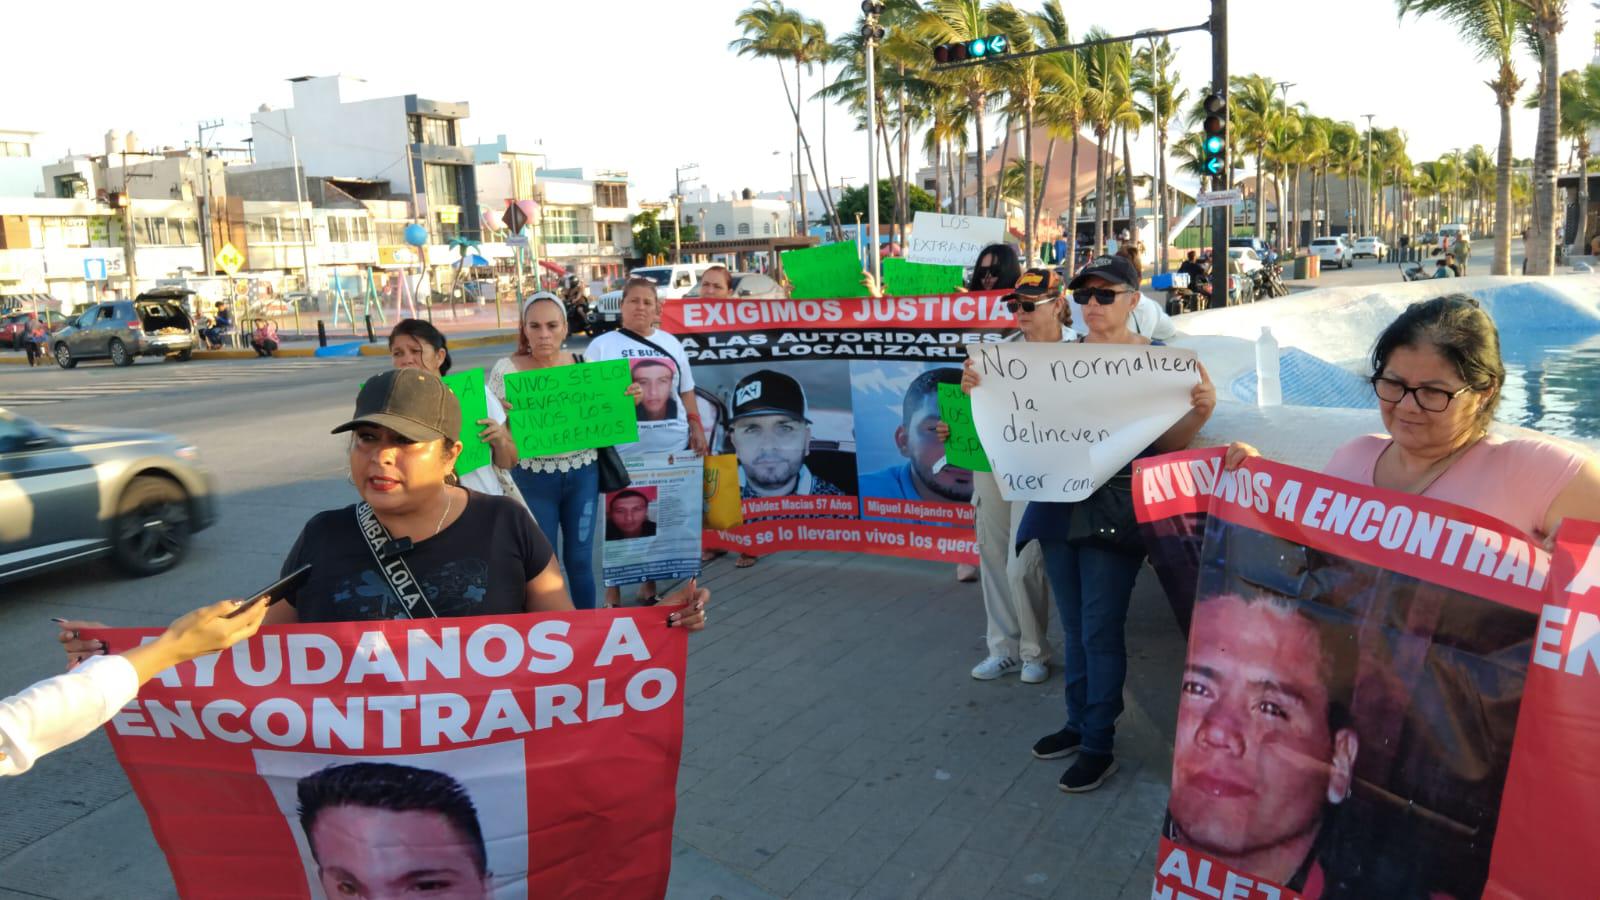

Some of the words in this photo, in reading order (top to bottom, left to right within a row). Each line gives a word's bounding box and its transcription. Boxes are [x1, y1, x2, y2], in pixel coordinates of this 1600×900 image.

[941, 215, 969, 230] LOS
[683, 300, 843, 327] EXIGIMOS
[853, 295, 1014, 322] JUSTICIA
[621, 349, 635, 357] SE
[682, 338, 700, 348] A
[708, 334, 768, 347] LAS
[778, 332, 1004, 344] AUTORIDADES
[685, 348, 762, 360] PARA
[981, 345, 1027, 380] No
[1051, 351, 1199, 383] normalizen
[508, 375, 559, 394] VIVOS
[568, 368, 592, 386] SE
[1012, 391, 1038, 411] la
[512, 411, 568, 430] VIVOS
[579, 402, 613, 420] LOS
[523, 420, 625, 451] QUEREMOS
[749, 501, 779, 512] Valdez
[867, 500, 901, 516] Miguel
[904, 503, 953, 519] Alejandro
[1275, 481, 1302, 523] A
[756, 530, 774, 543] se
[778, 526, 793, 541] lo
[798, 526, 861, 541] llevaron
[865, 528, 904, 546] vivos
[909, 533, 932, 550] los
[358, 502, 388, 552] BIMBA
[385, 560, 421, 610] LOLA
[594, 617, 652, 667] A
[112, 667, 678, 750] ENCONTRARLO
